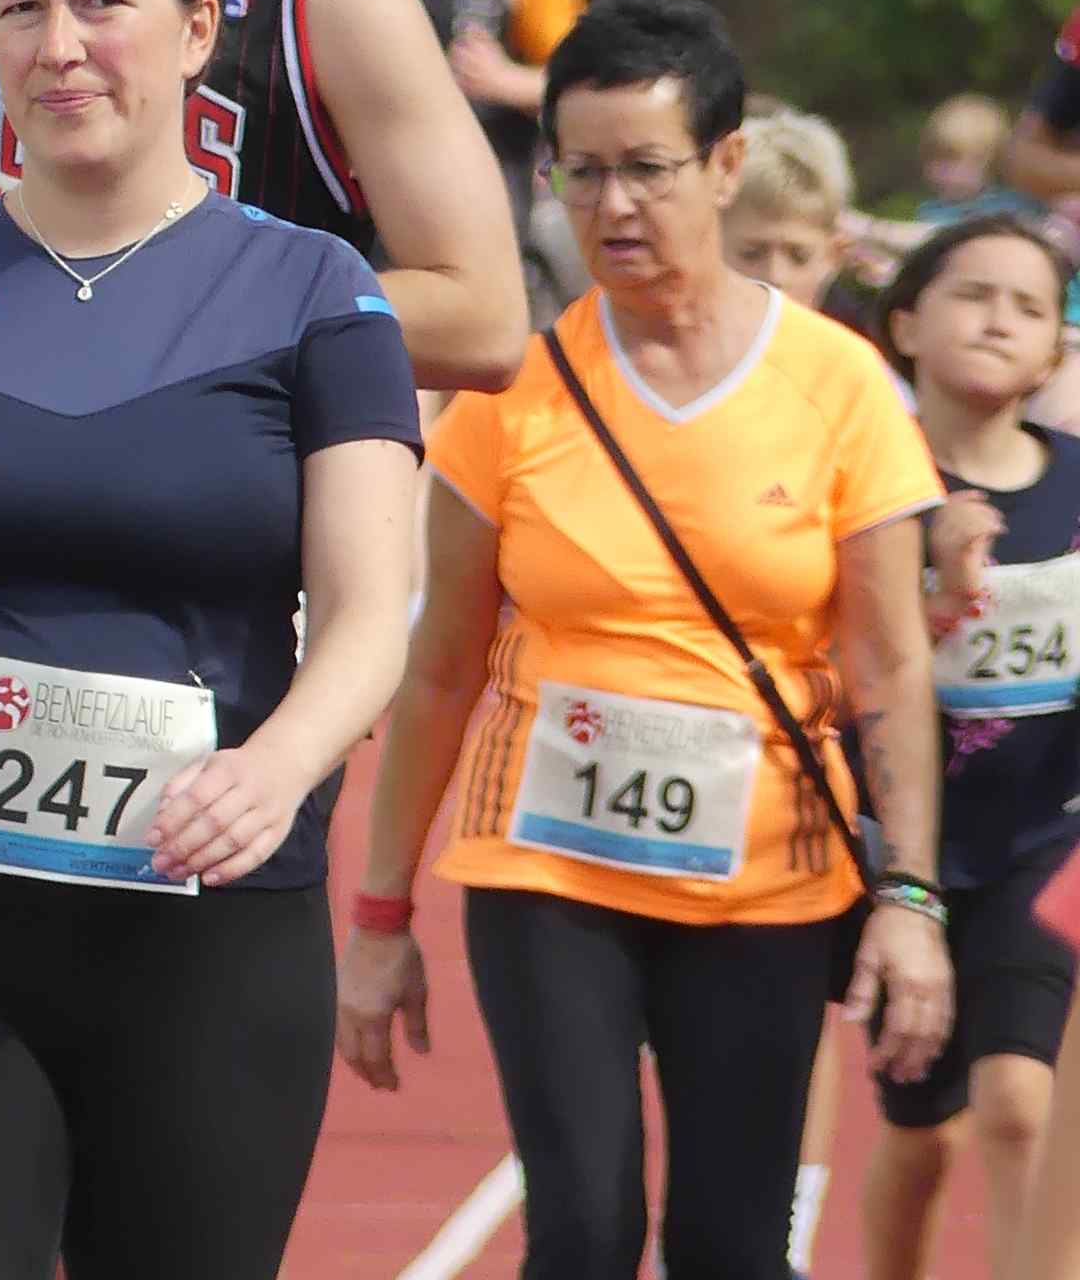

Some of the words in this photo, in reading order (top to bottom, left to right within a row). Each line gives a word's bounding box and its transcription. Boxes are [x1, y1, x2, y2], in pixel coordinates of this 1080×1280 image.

[968, 622, 1069, 679] 254
[32, 681, 175, 738] BENEFIZLAUF
[574, 761, 697, 834] 149
